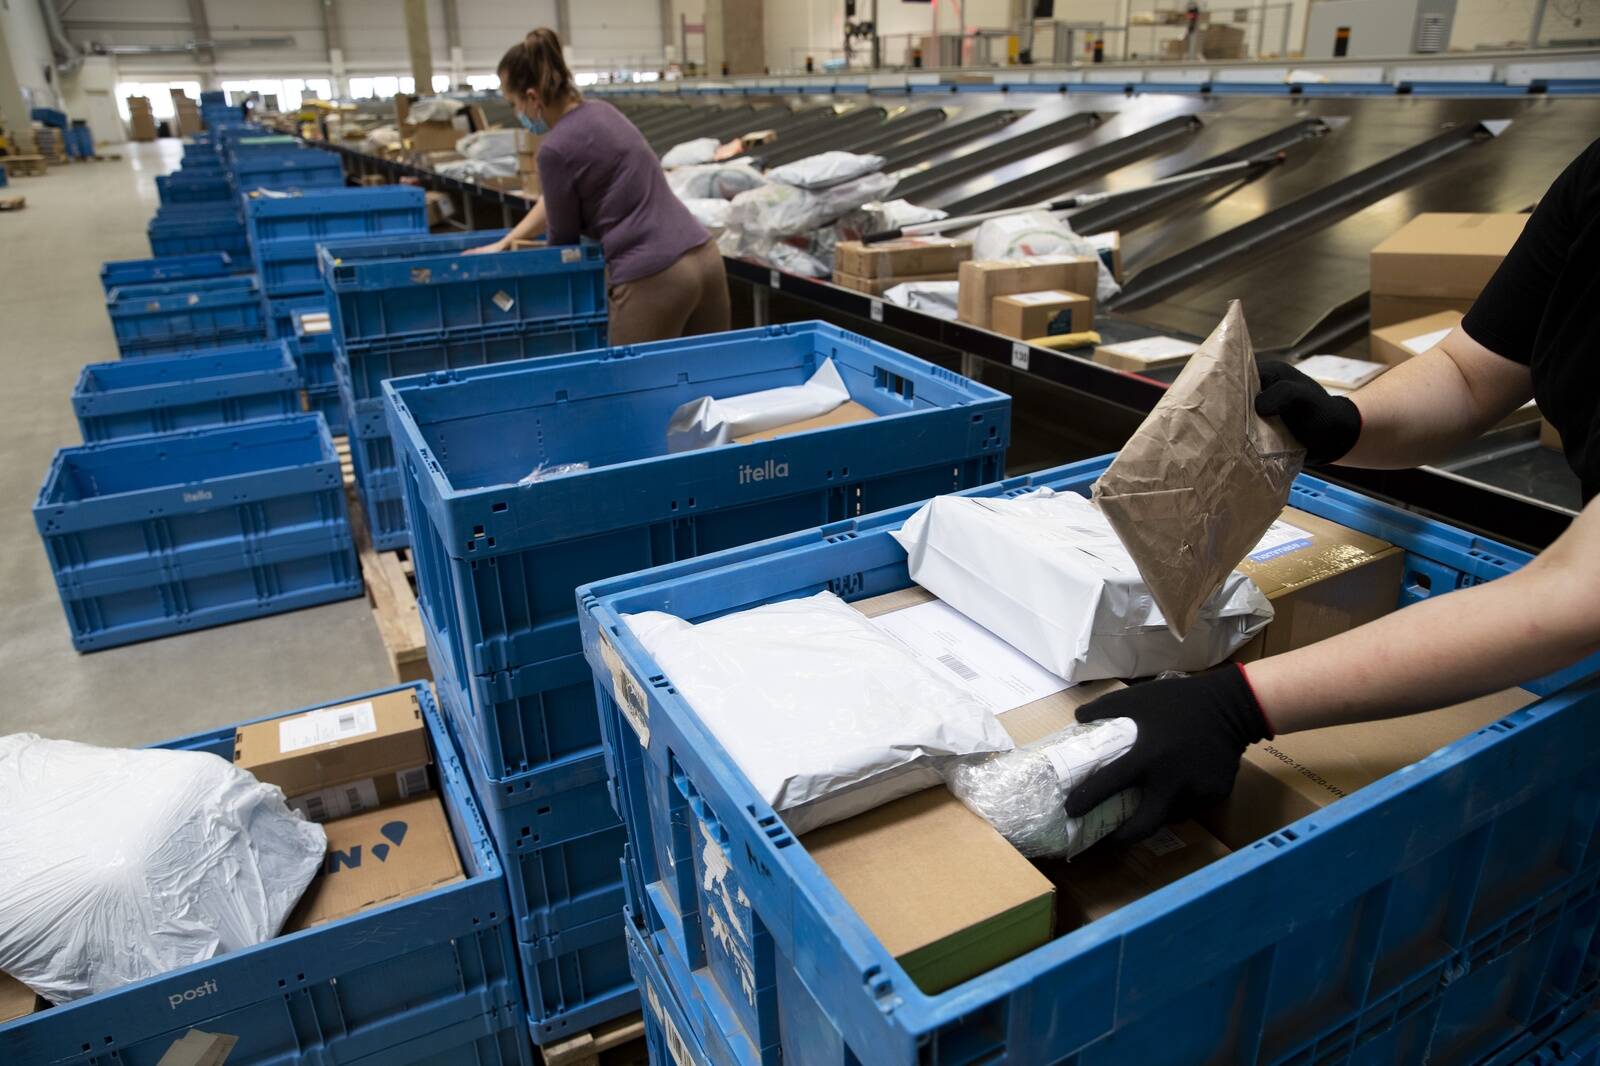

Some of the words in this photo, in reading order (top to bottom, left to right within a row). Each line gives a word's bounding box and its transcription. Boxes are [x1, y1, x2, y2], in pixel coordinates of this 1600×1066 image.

[738, 459, 789, 485] itella
[320, 844, 362, 875] N
[168, 979, 218, 1010] posti
